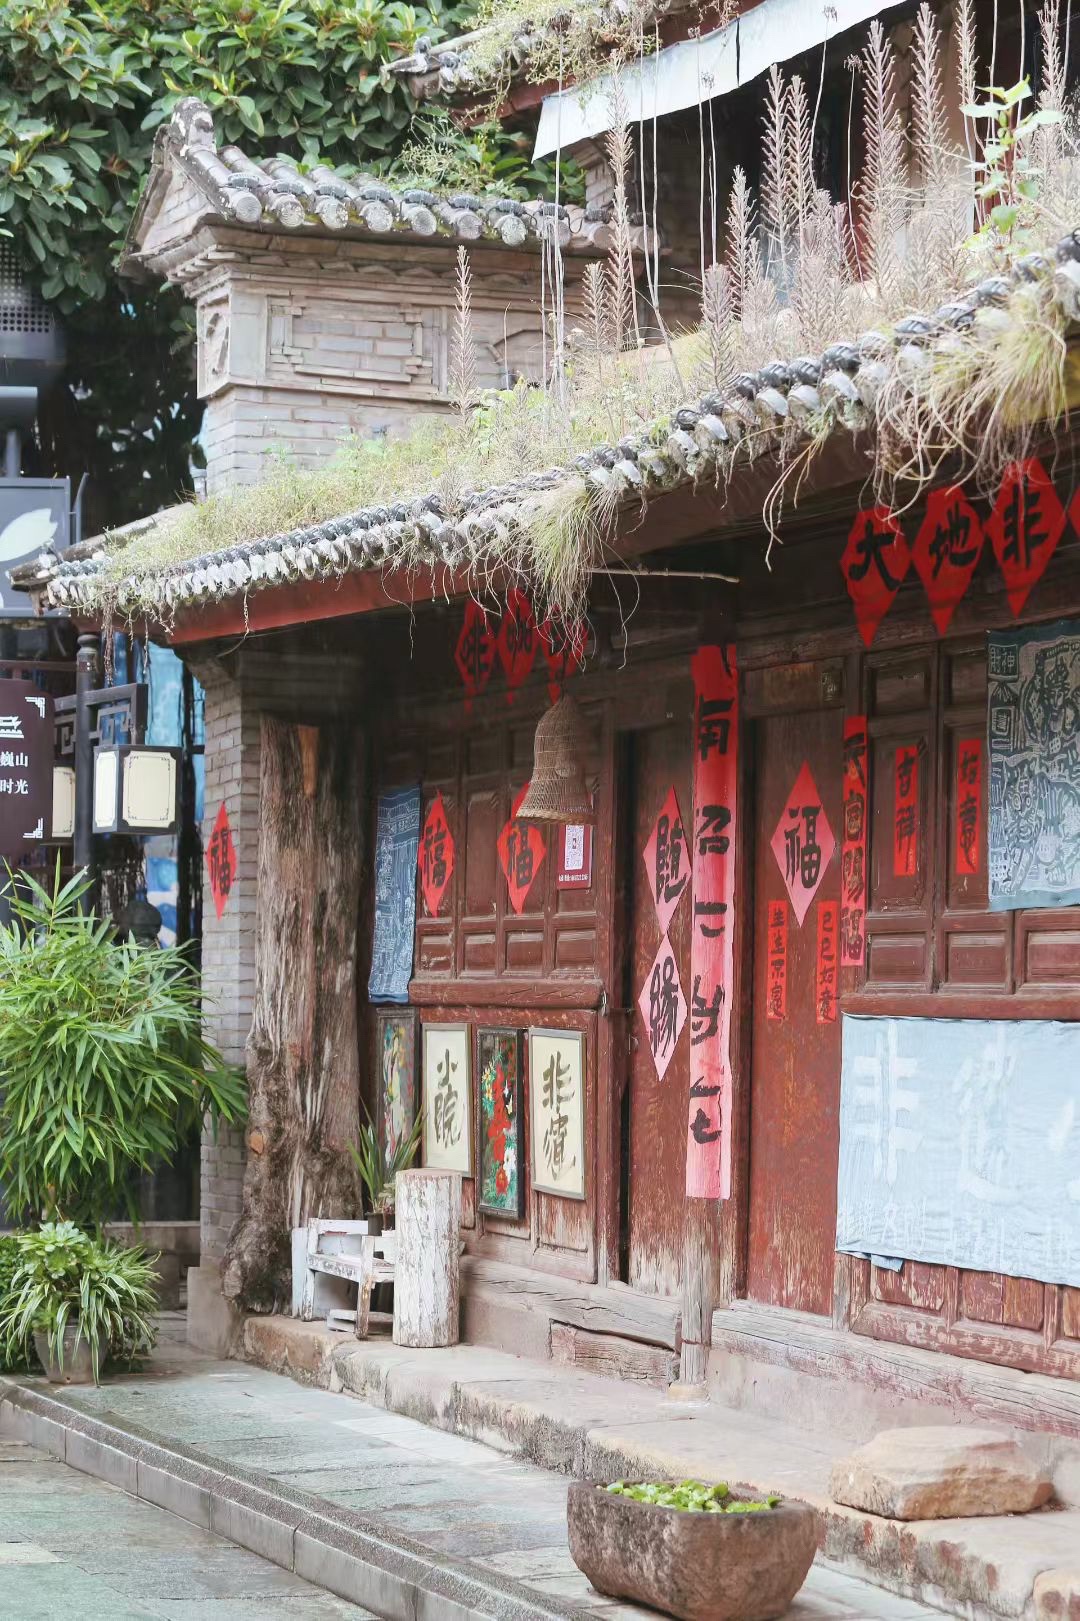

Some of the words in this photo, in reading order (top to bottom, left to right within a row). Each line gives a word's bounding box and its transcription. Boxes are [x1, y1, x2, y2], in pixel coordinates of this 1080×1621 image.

[848, 518, 902, 592] 大
[210, 826, 231, 897] 福
[785, 804, 822, 889] 福
[434, 1048, 463, 1149] 小院
